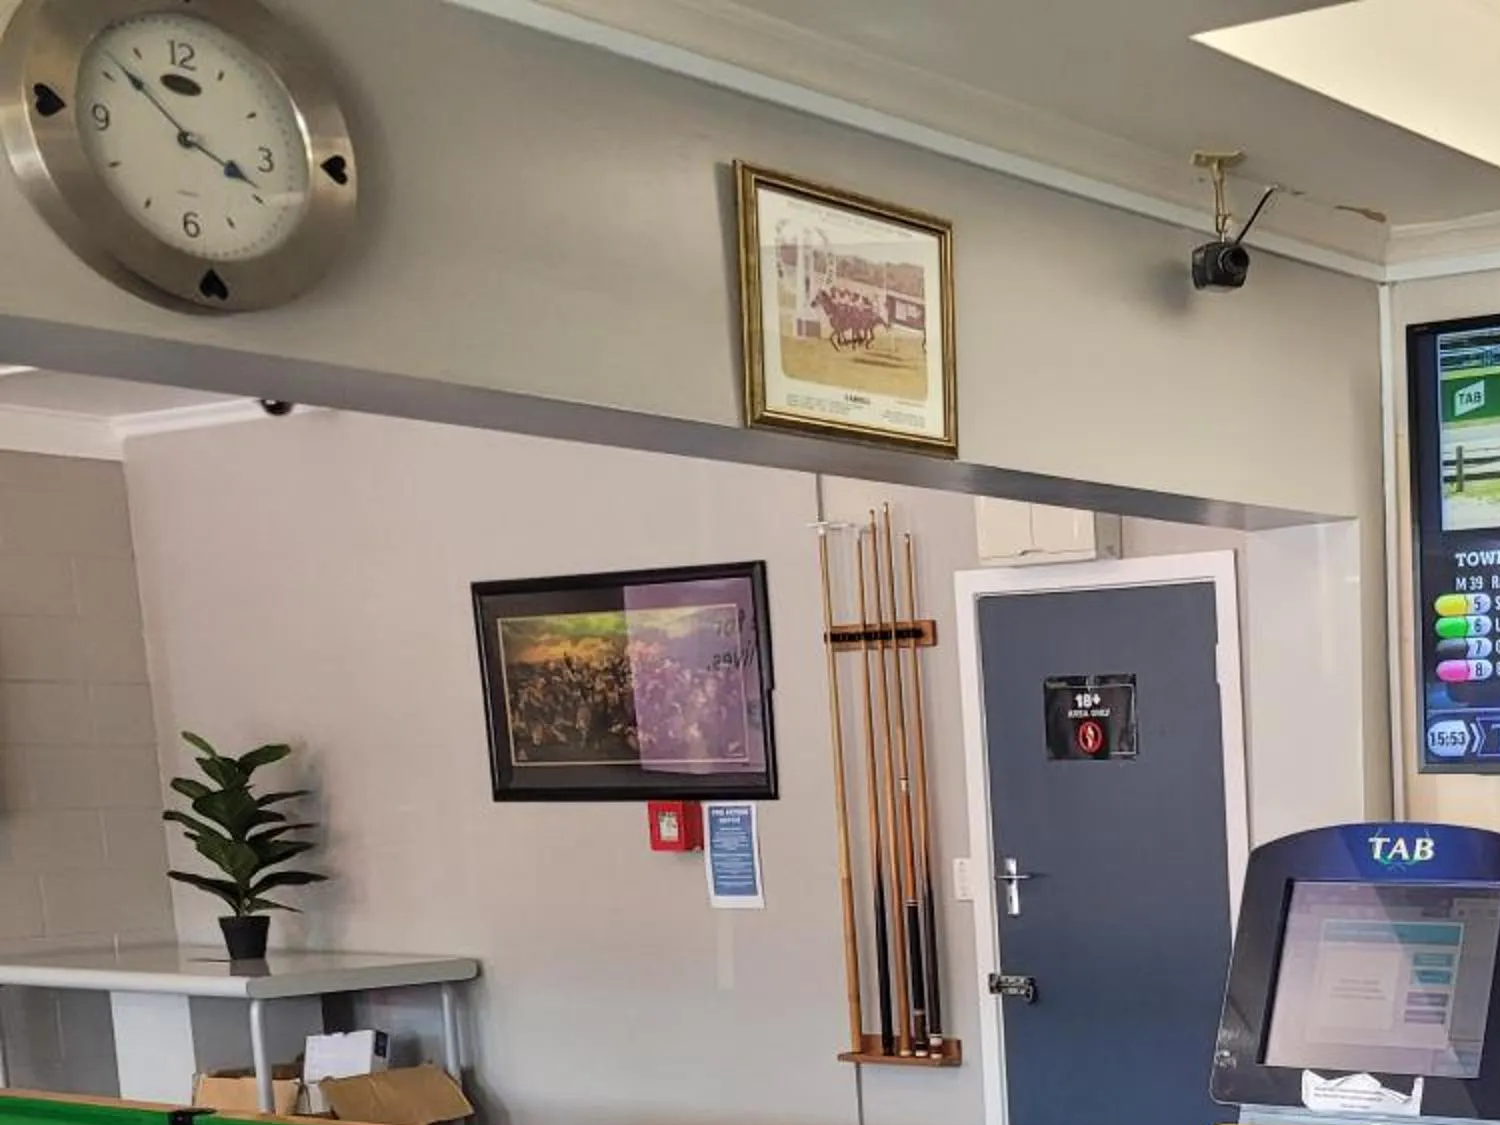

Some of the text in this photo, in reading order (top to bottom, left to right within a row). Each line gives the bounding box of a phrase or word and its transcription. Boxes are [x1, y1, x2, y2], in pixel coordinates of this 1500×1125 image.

[166, 40, 196, 71] 12
[92, 103, 110, 131] 9
[257, 146, 274, 173] 3
[182, 211, 200, 238] 6
[1458, 392, 1482, 405] TAB
[1474, 597, 1482, 610] 5
[1474, 619, 1482, 632] 6
[1476, 662, 1483, 677] 8
[1429, 730, 1465, 745] 15:53
[1368, 837, 1435, 861] TAB
